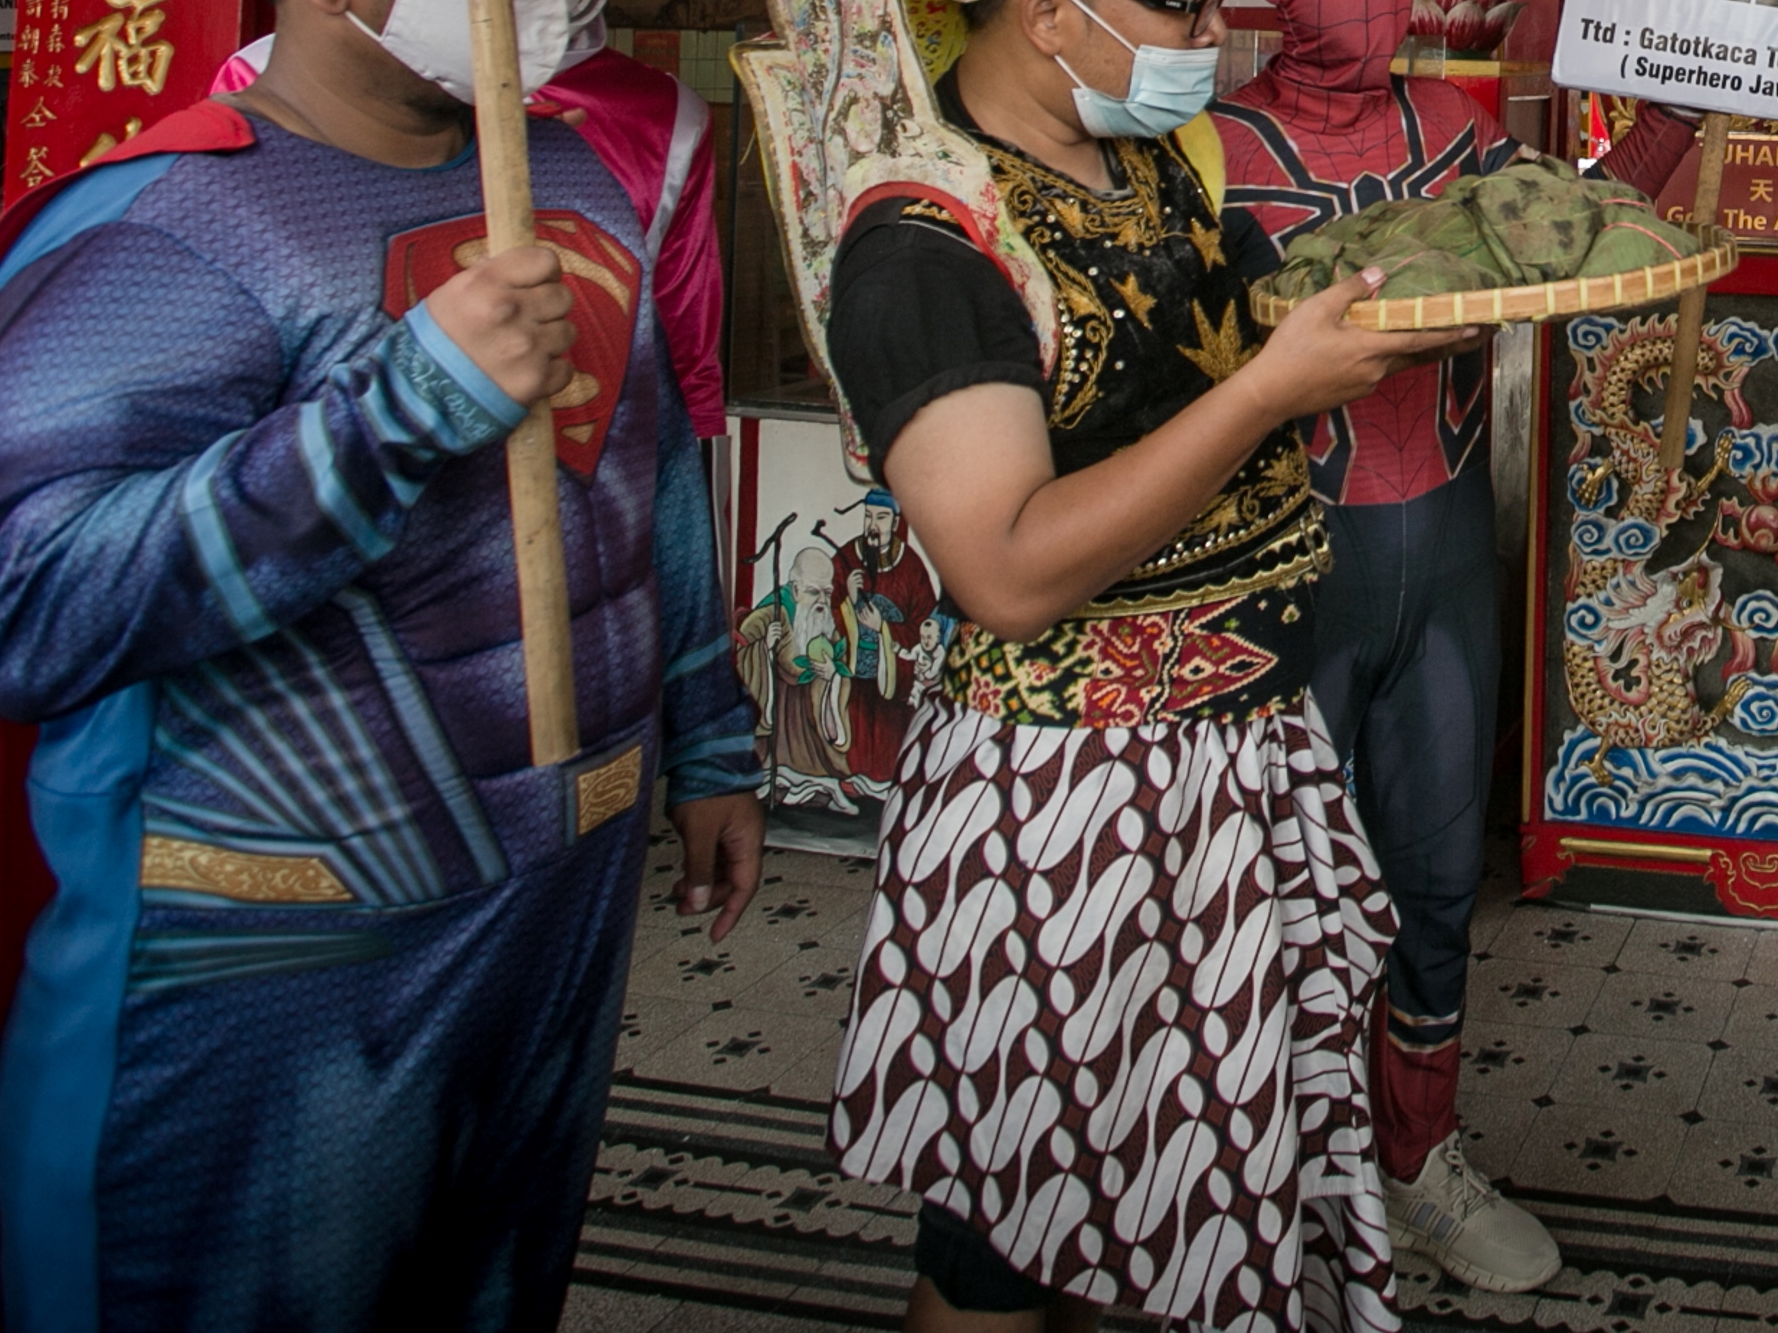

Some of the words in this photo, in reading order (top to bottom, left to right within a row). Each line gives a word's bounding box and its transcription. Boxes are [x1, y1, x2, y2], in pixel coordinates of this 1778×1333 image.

[1579, 18, 1618, 45] Ttd
[1639, 26, 1758, 66] Gatotkaca
[1634, 56, 1743, 93] Superhero
[1723, 208, 1768, 231] The
